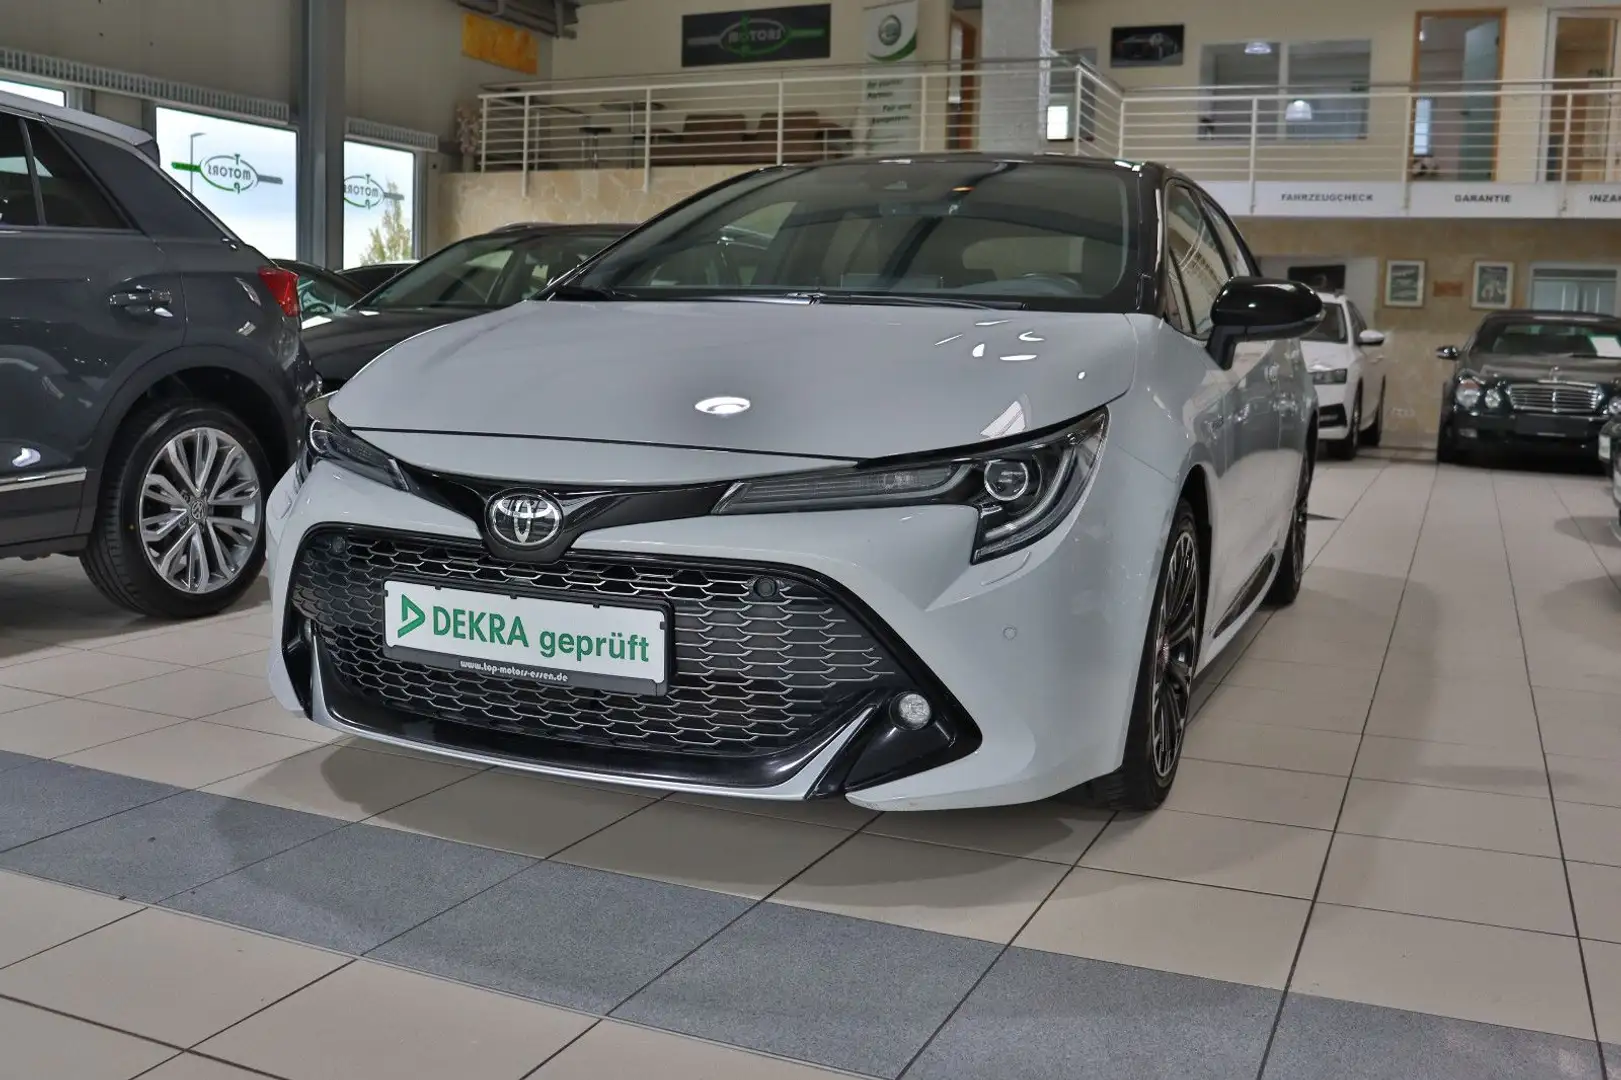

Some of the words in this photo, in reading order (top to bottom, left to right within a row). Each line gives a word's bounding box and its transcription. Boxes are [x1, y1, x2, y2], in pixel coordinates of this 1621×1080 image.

[1281, 193, 1374, 203] FAHRZEUGCHECK
[1454, 193, 1512, 203] GARANTIE
[432, 605, 530, 648] DEKRA
[538, 630, 650, 662] geprüft
[459, 659, 569, 682] www.top-motors-essen.de
